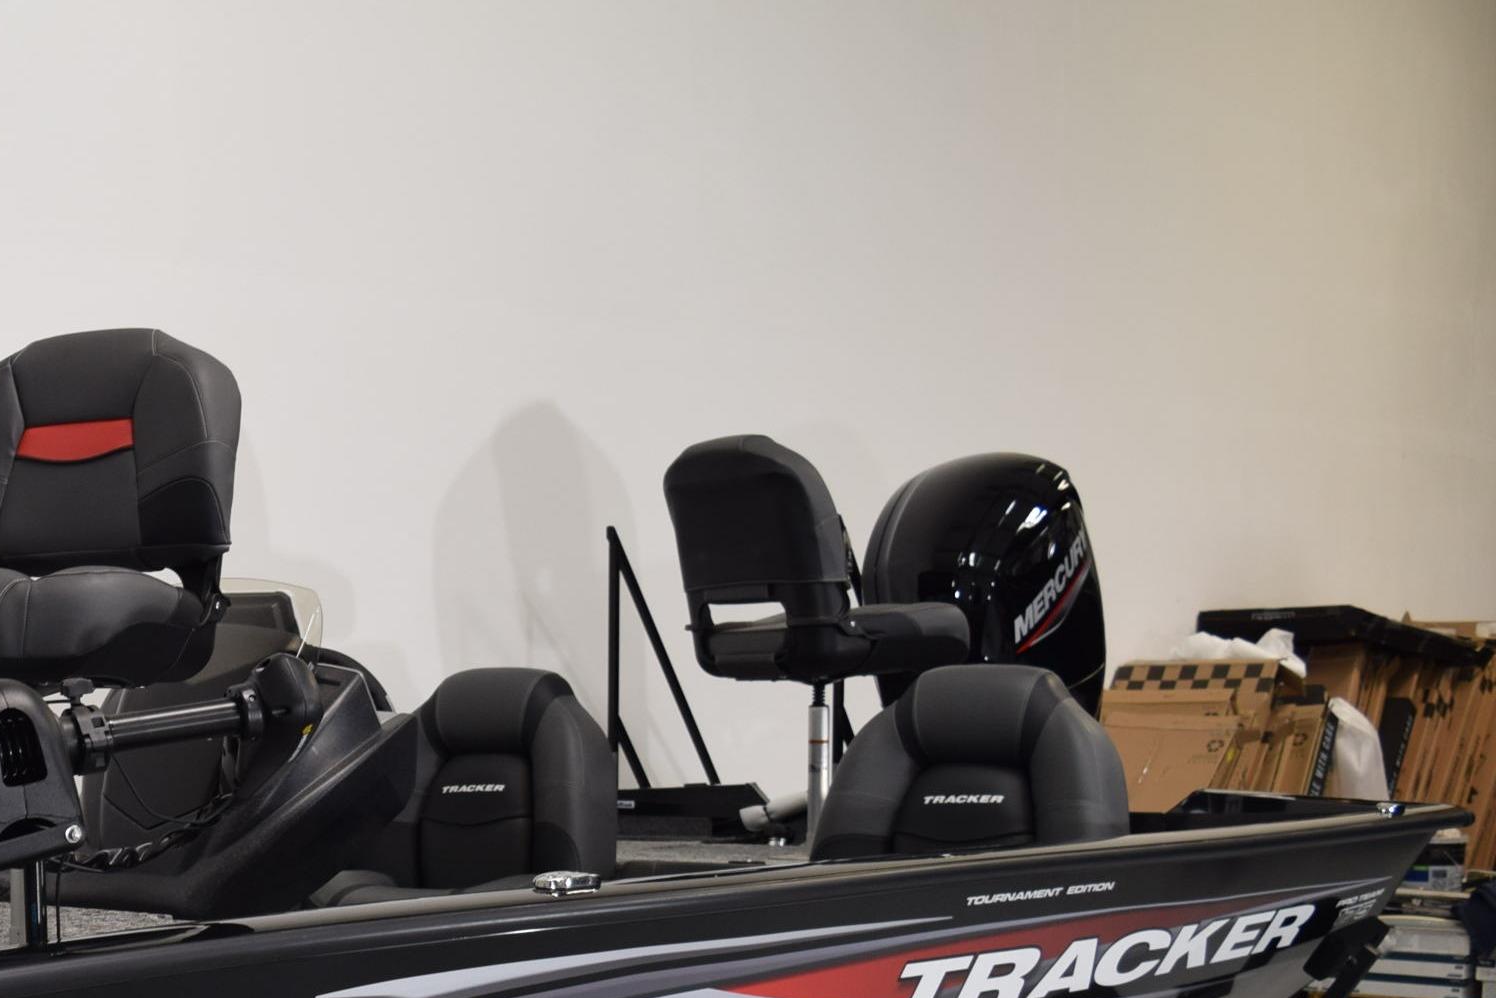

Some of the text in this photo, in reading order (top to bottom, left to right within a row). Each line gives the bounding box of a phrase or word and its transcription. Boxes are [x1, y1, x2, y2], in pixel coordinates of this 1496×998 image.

[442, 784, 505, 794] TRACKER
[924, 795, 1004, 805] TRACKER
[966, 881, 1116, 906] TOURNAMENT EDITION
